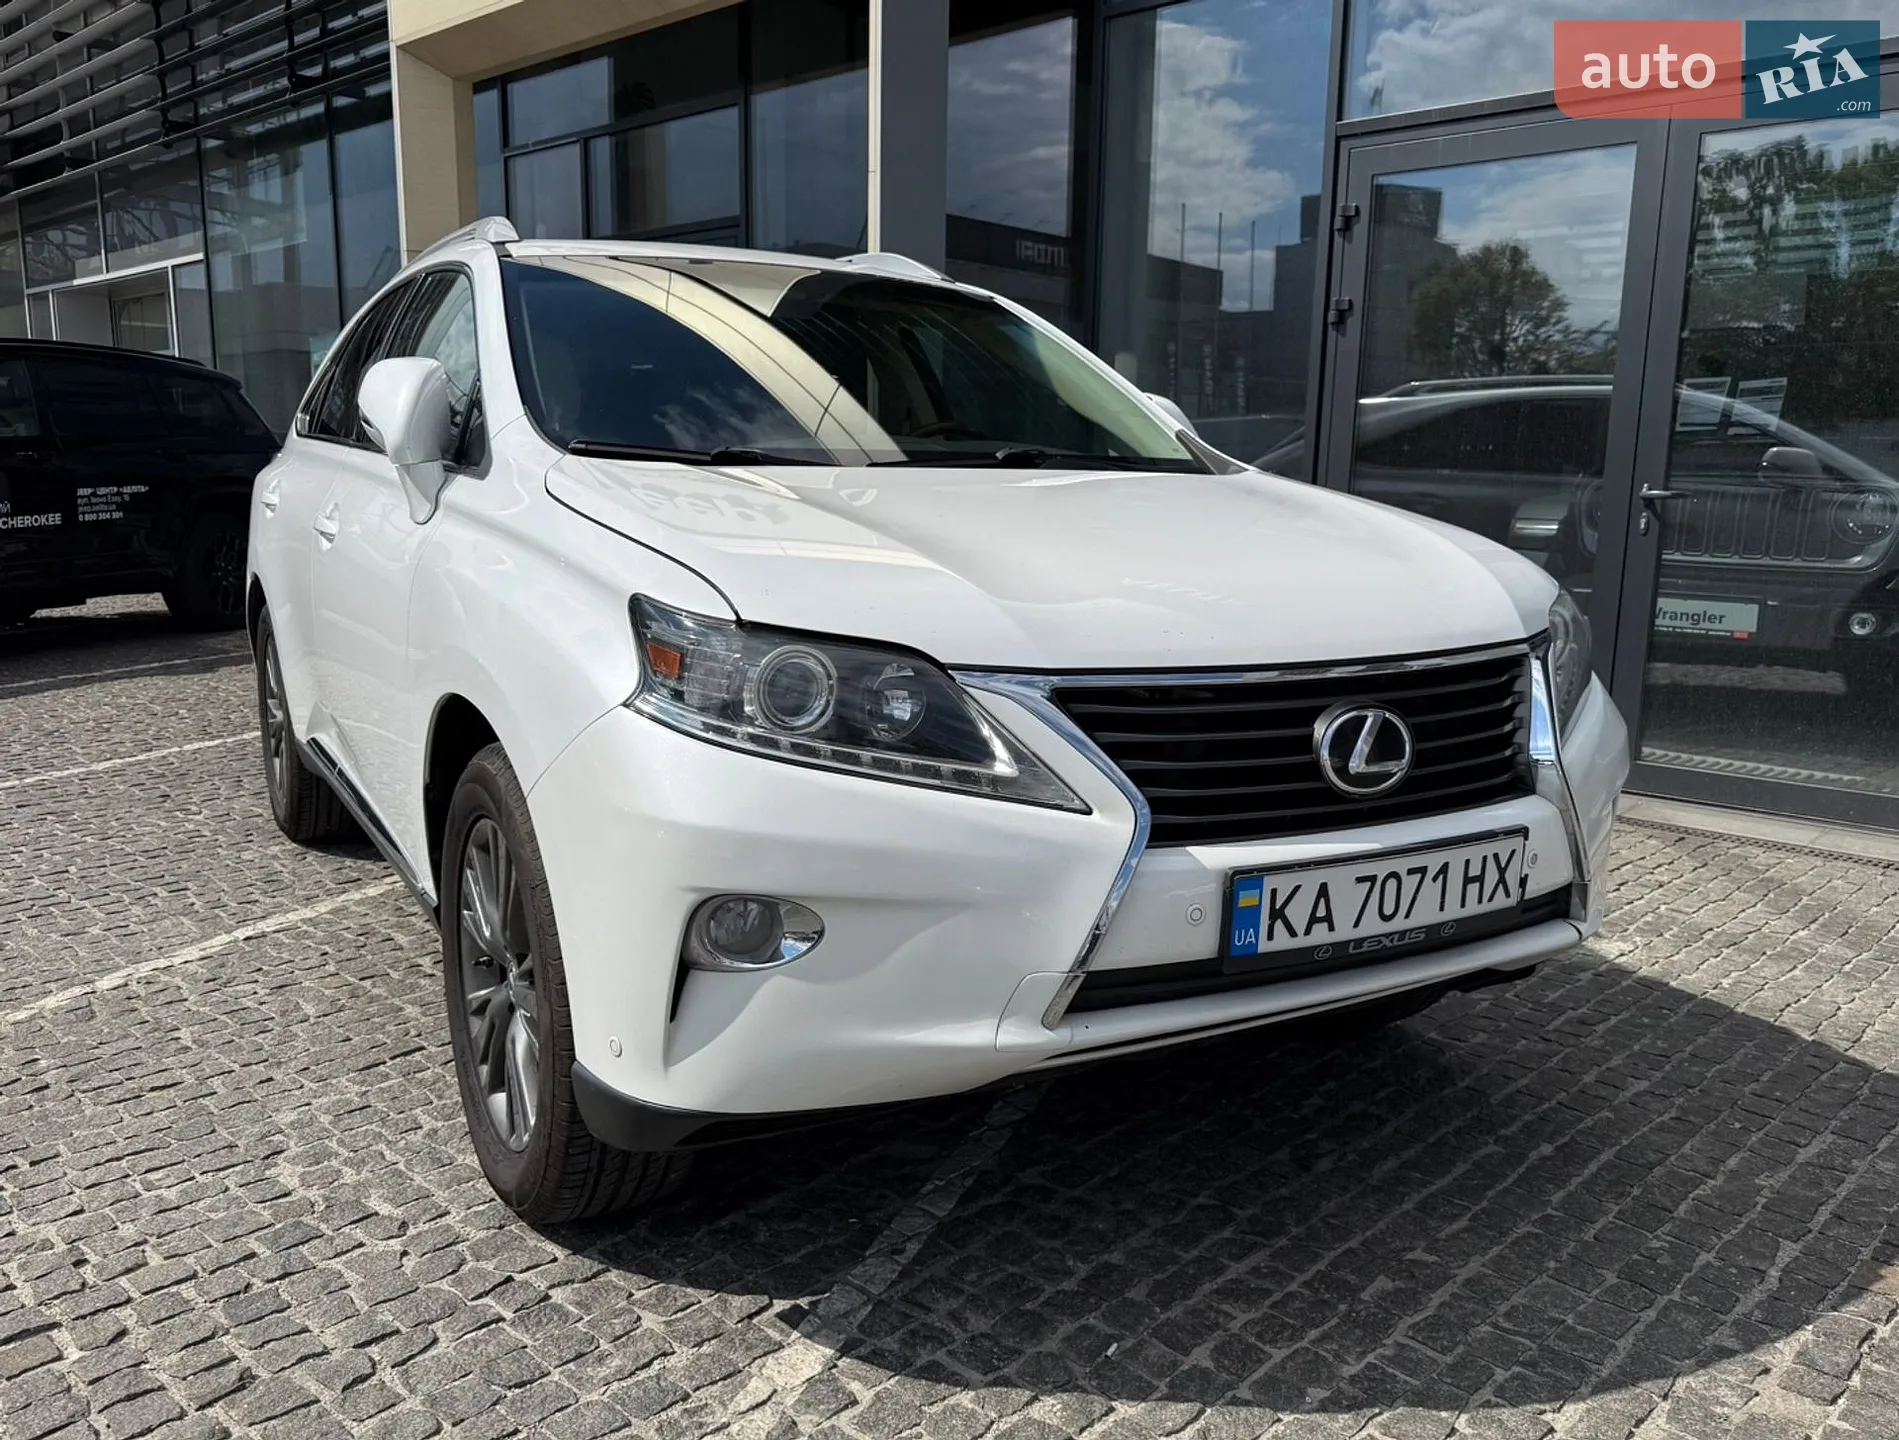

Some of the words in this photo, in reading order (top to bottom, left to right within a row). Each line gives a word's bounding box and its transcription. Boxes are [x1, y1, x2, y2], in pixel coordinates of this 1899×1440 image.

[0, 512, 62, 530] CHEROKEE
[1266, 881, 1335, 941] KA
[1352, 861, 1450, 929] 7071
[1460, 848, 1517, 909] HX
[1234, 927, 1257, 946] UA
[1349, 927, 1427, 953] LEXUS
